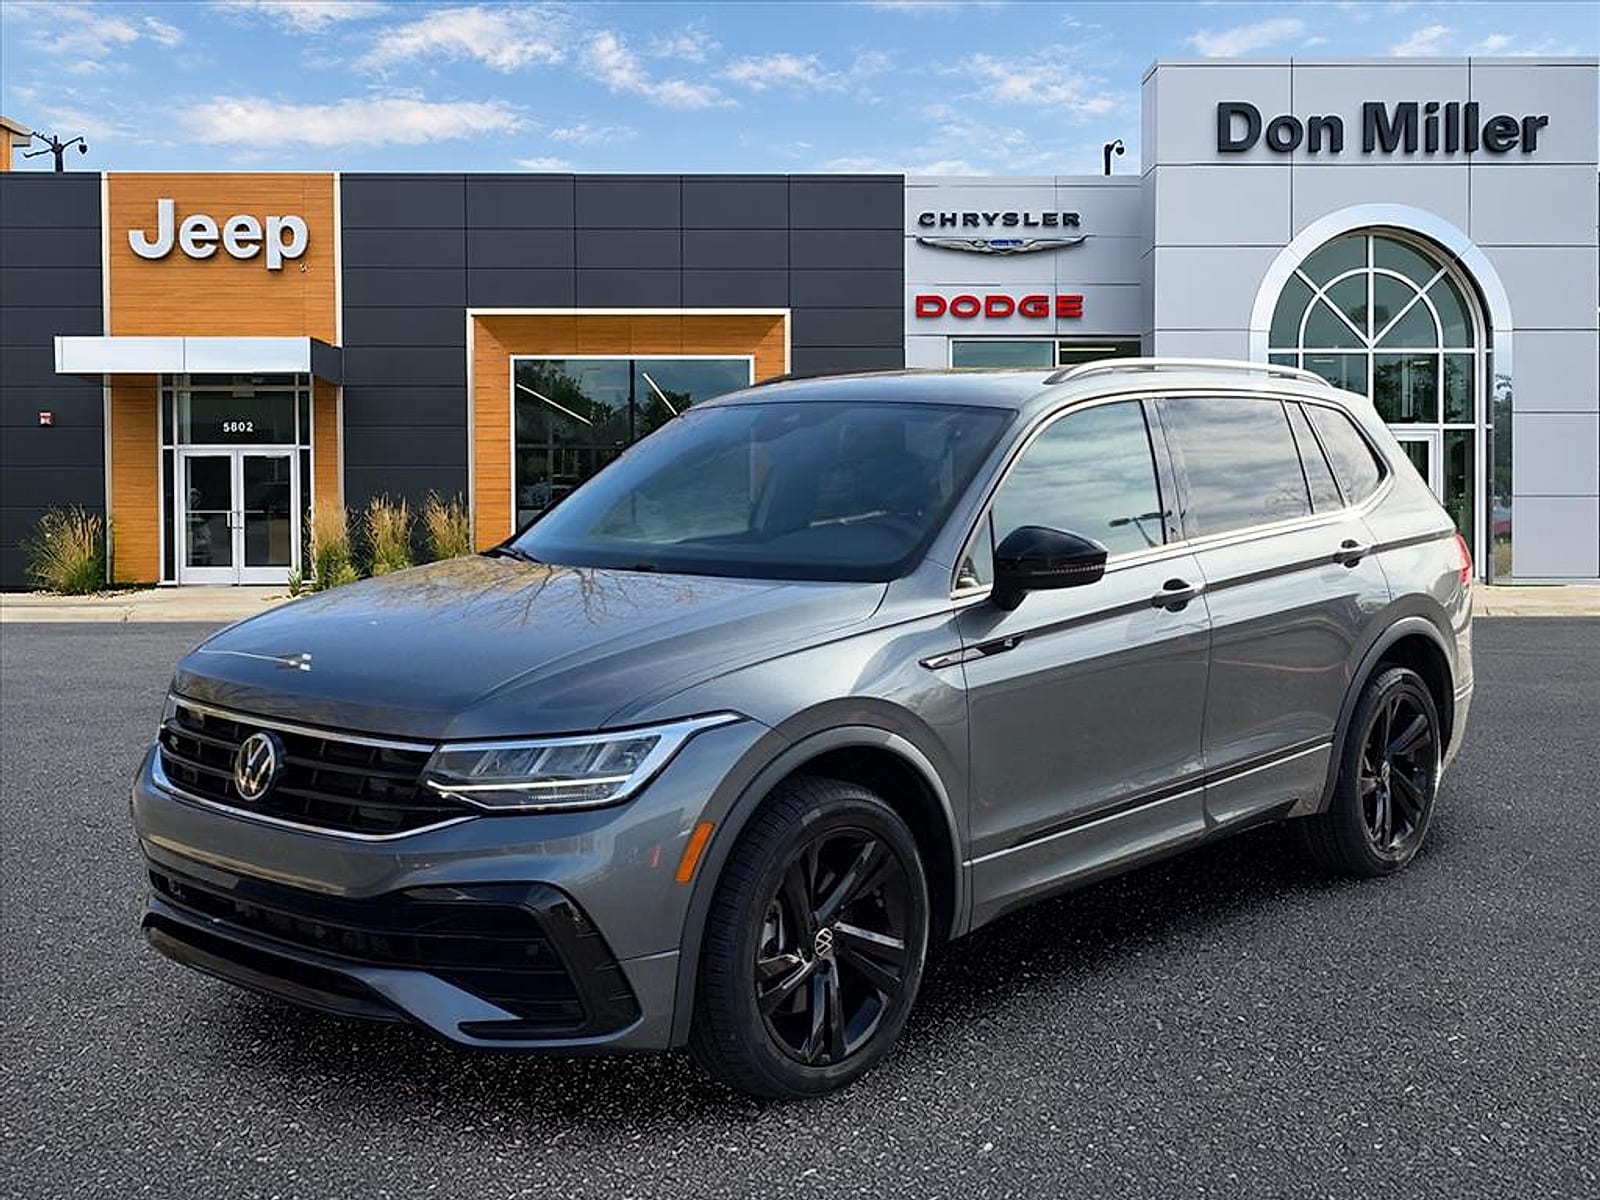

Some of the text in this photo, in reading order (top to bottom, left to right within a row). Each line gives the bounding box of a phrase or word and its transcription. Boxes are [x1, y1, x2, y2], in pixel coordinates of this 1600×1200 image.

[1217, 101, 1549, 153] Don Miller
[128, 199, 309, 270] Jeep
[918, 213, 1081, 227] CHRYSLER
[915, 295, 1084, 318] DODGE
